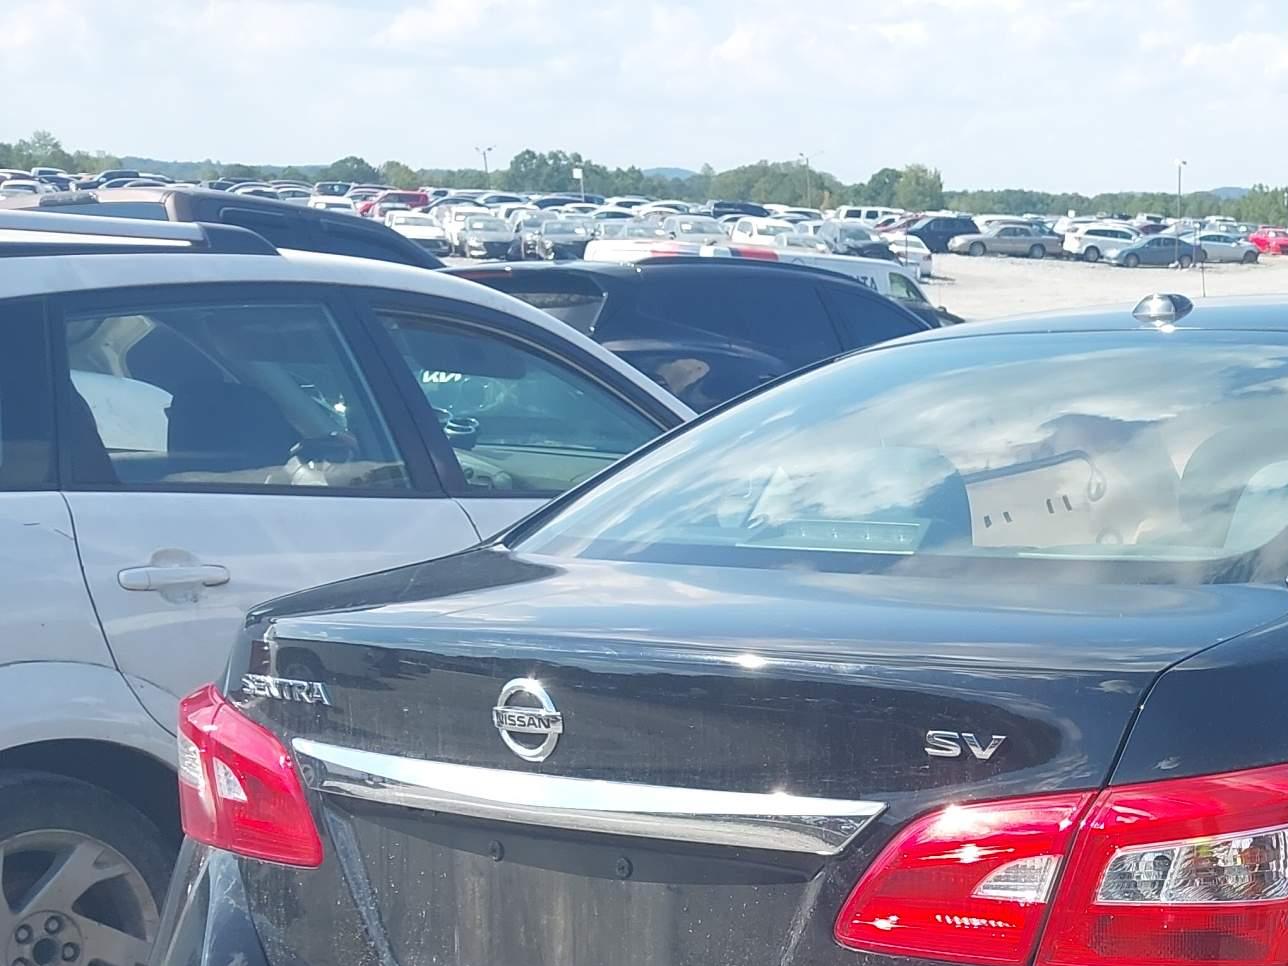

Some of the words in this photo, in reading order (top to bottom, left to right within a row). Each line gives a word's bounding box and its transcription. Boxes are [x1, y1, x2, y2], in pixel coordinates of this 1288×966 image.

[241, 673, 331, 706] SENTRA
[497, 712, 551, 729] NISSAN
[924, 730, 1007, 759] SV
